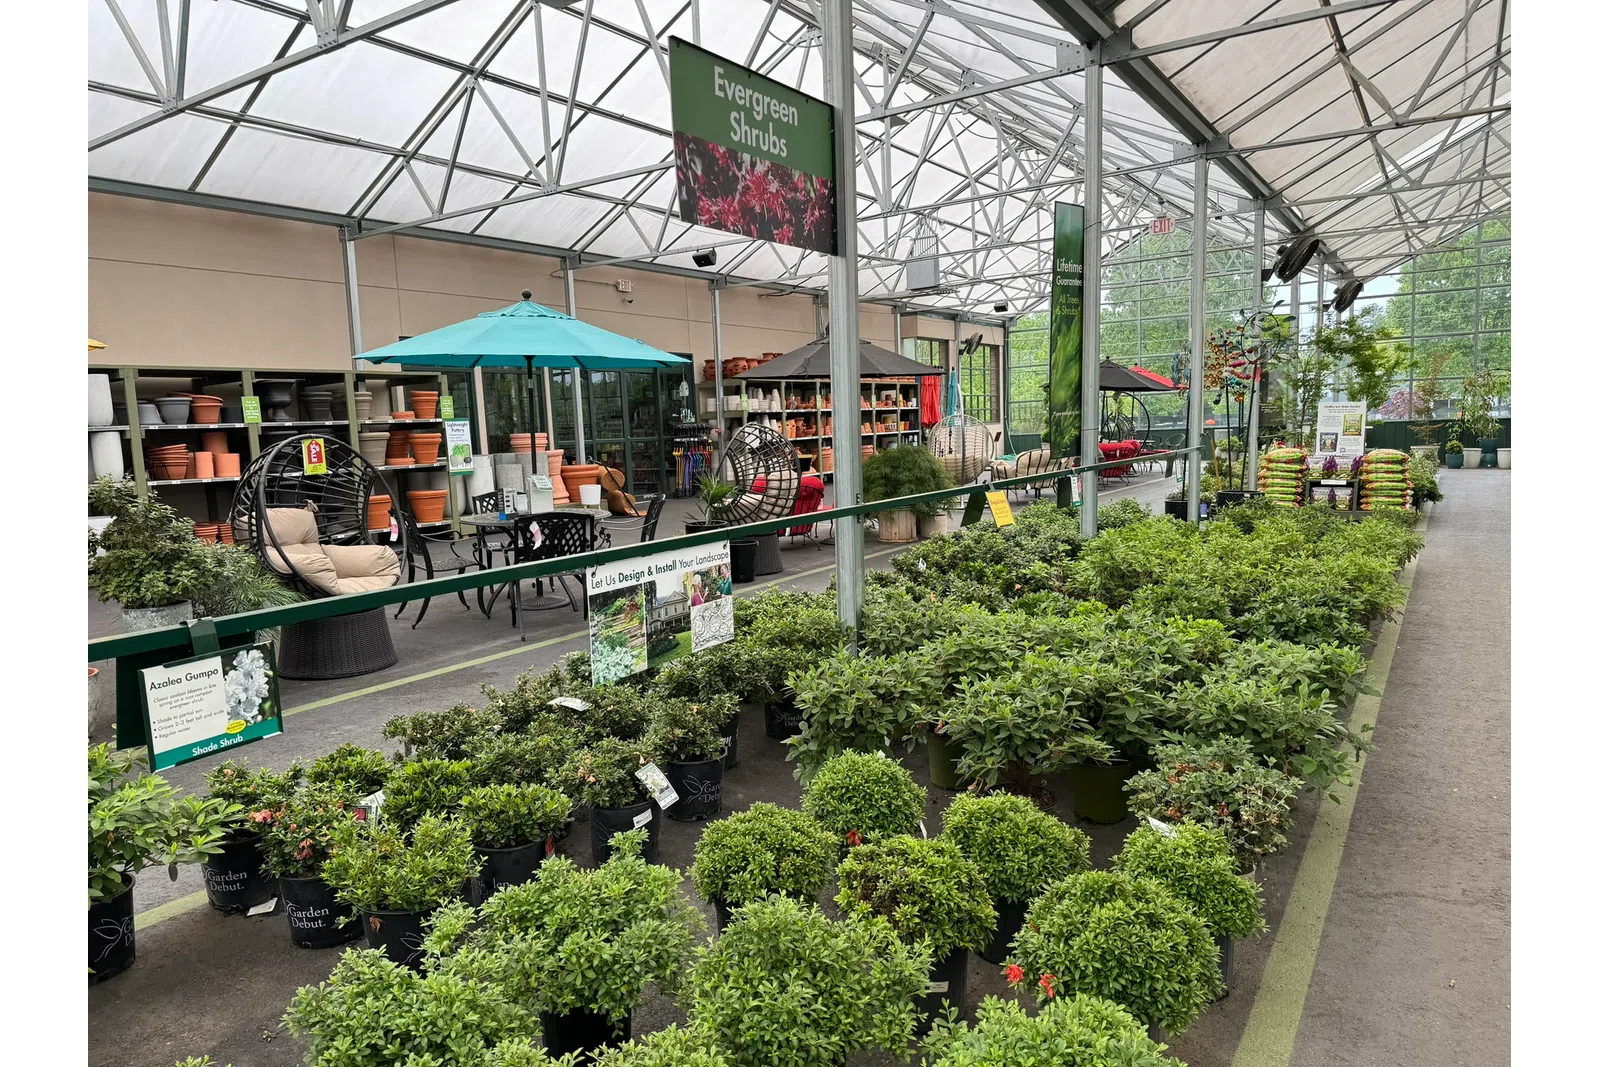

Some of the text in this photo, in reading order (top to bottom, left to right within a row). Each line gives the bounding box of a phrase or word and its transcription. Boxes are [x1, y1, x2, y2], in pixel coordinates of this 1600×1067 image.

[714, 65, 798, 126] Evergreen
[730, 111, 788, 157] Shrubs
[1153, 217, 1172, 234] EXIT
[1056, 258, 1083, 273] Lifetime
[1055, 275, 1083, 287] Guarantee
[310, 444, 318, 463] SALE
[591, 551, 729, 590] Let Us Design & Install Your Landscape
[149, 668, 219, 691] Azalea Gumpo
[153, 695, 169, 704] Classic
[159, 699, 173, 708] spring
[194, 689, 213, 698] compact
[169, 700, 191, 710] evergreen
[157, 715, 172, 725] Shade
[179, 709, 194, 719] partial
[157, 724, 174, 732] Grows
[158, 730, 177, 739] Regular
[192, 734, 243, 757] Shade Shrub
[704, 783, 720, 793] Gar
[704, 791, 720, 803] Deb
[208, 870, 248, 882] Garden
[289, 906, 330, 918] Garden
